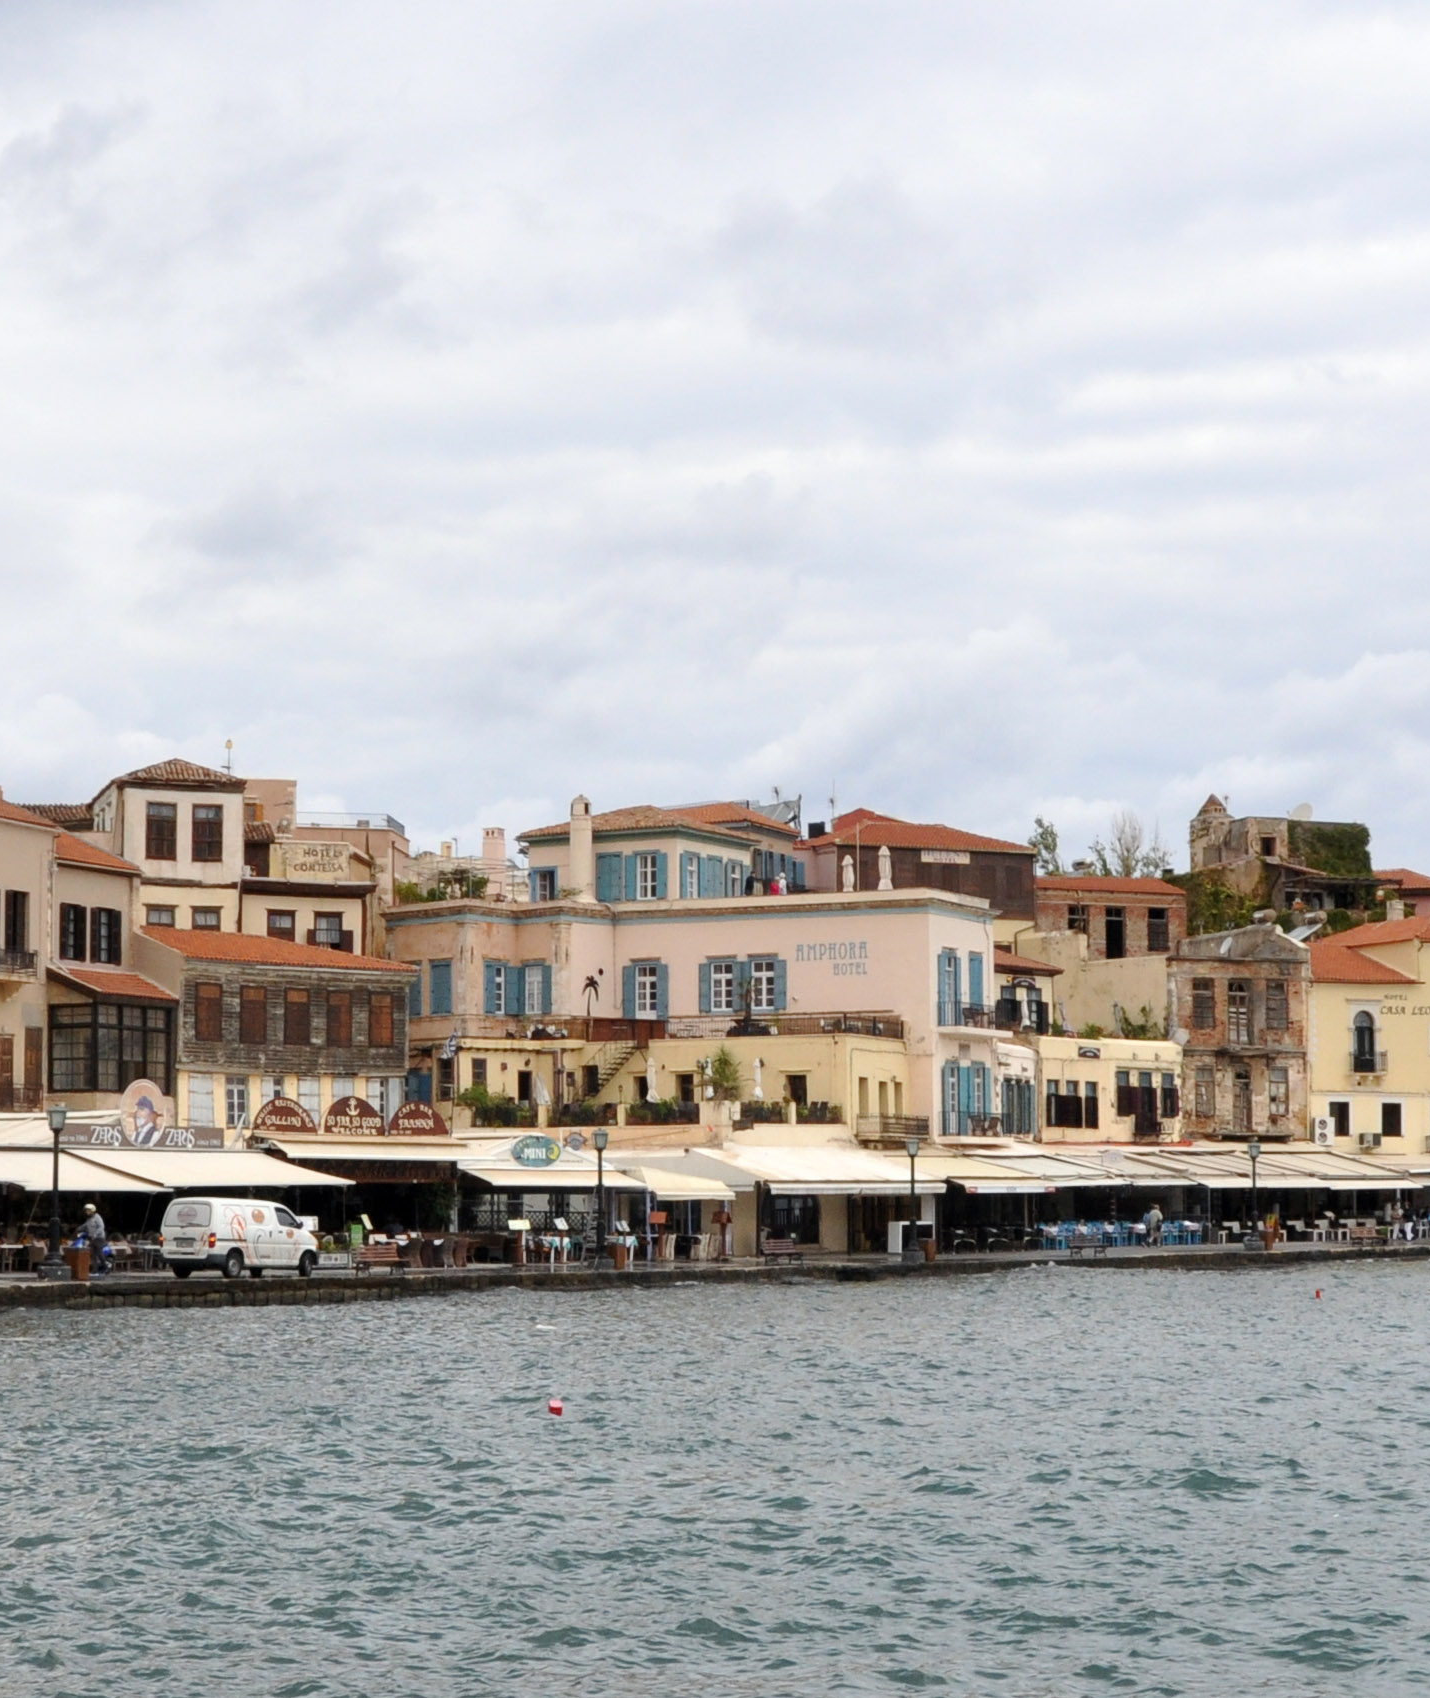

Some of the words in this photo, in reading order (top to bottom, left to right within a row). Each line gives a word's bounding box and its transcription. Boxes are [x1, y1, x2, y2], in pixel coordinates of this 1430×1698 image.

[795, 942, 868, 962] AMPHORA
[833, 963, 868, 976] HOTEL
[1380, 1005, 1406, 1015] CASA
[327, 1116, 335, 1126] SO
[352, 1117, 361, 1127] SO
[362, 1117, 381, 1130] GOOD
